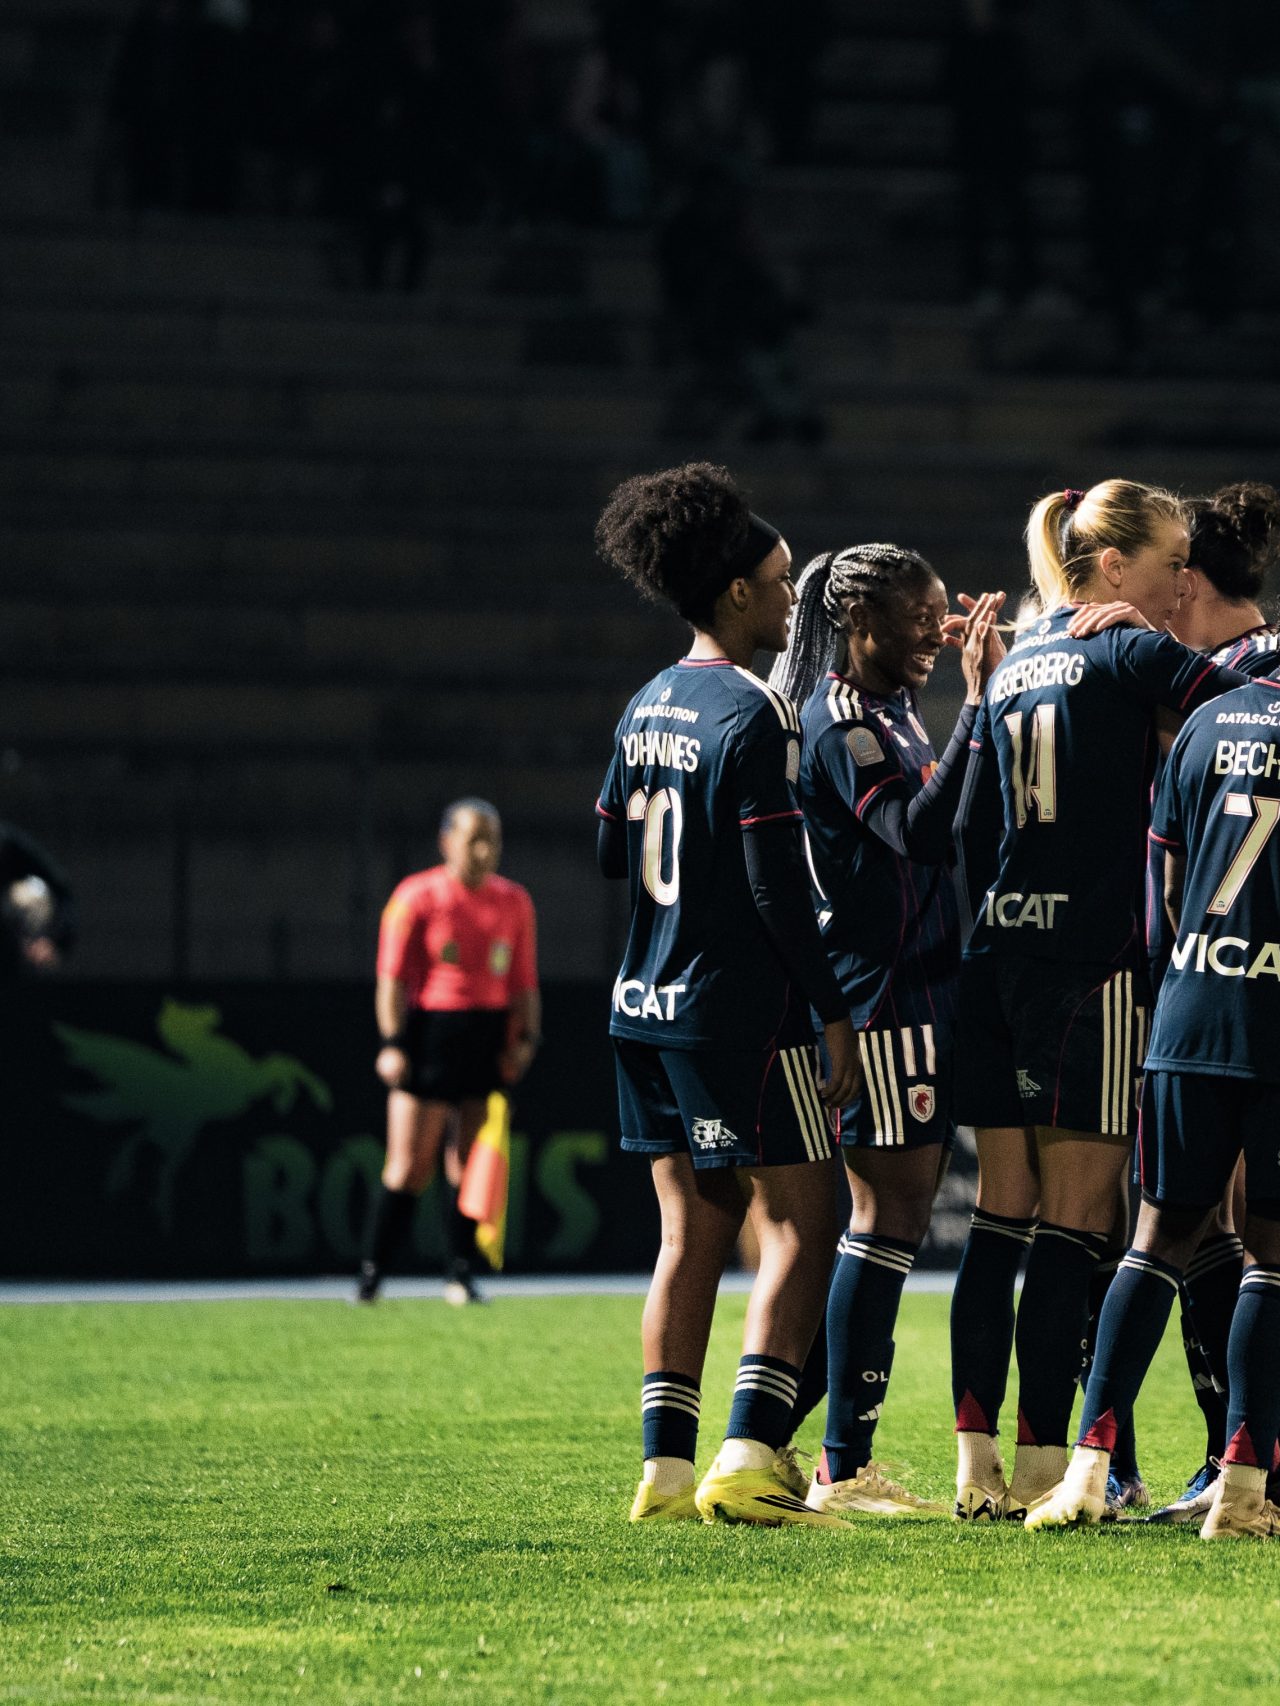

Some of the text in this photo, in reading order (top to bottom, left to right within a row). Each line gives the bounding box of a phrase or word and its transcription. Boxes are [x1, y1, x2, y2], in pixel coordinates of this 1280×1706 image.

[990, 651, 1085, 706] EGERBERG
[1004, 704, 1056, 829] 14
[986, 890, 1070, 930] ICAT
[612, 976, 686, 1021] ICAT
[861, 1369, 889, 1383] OL
